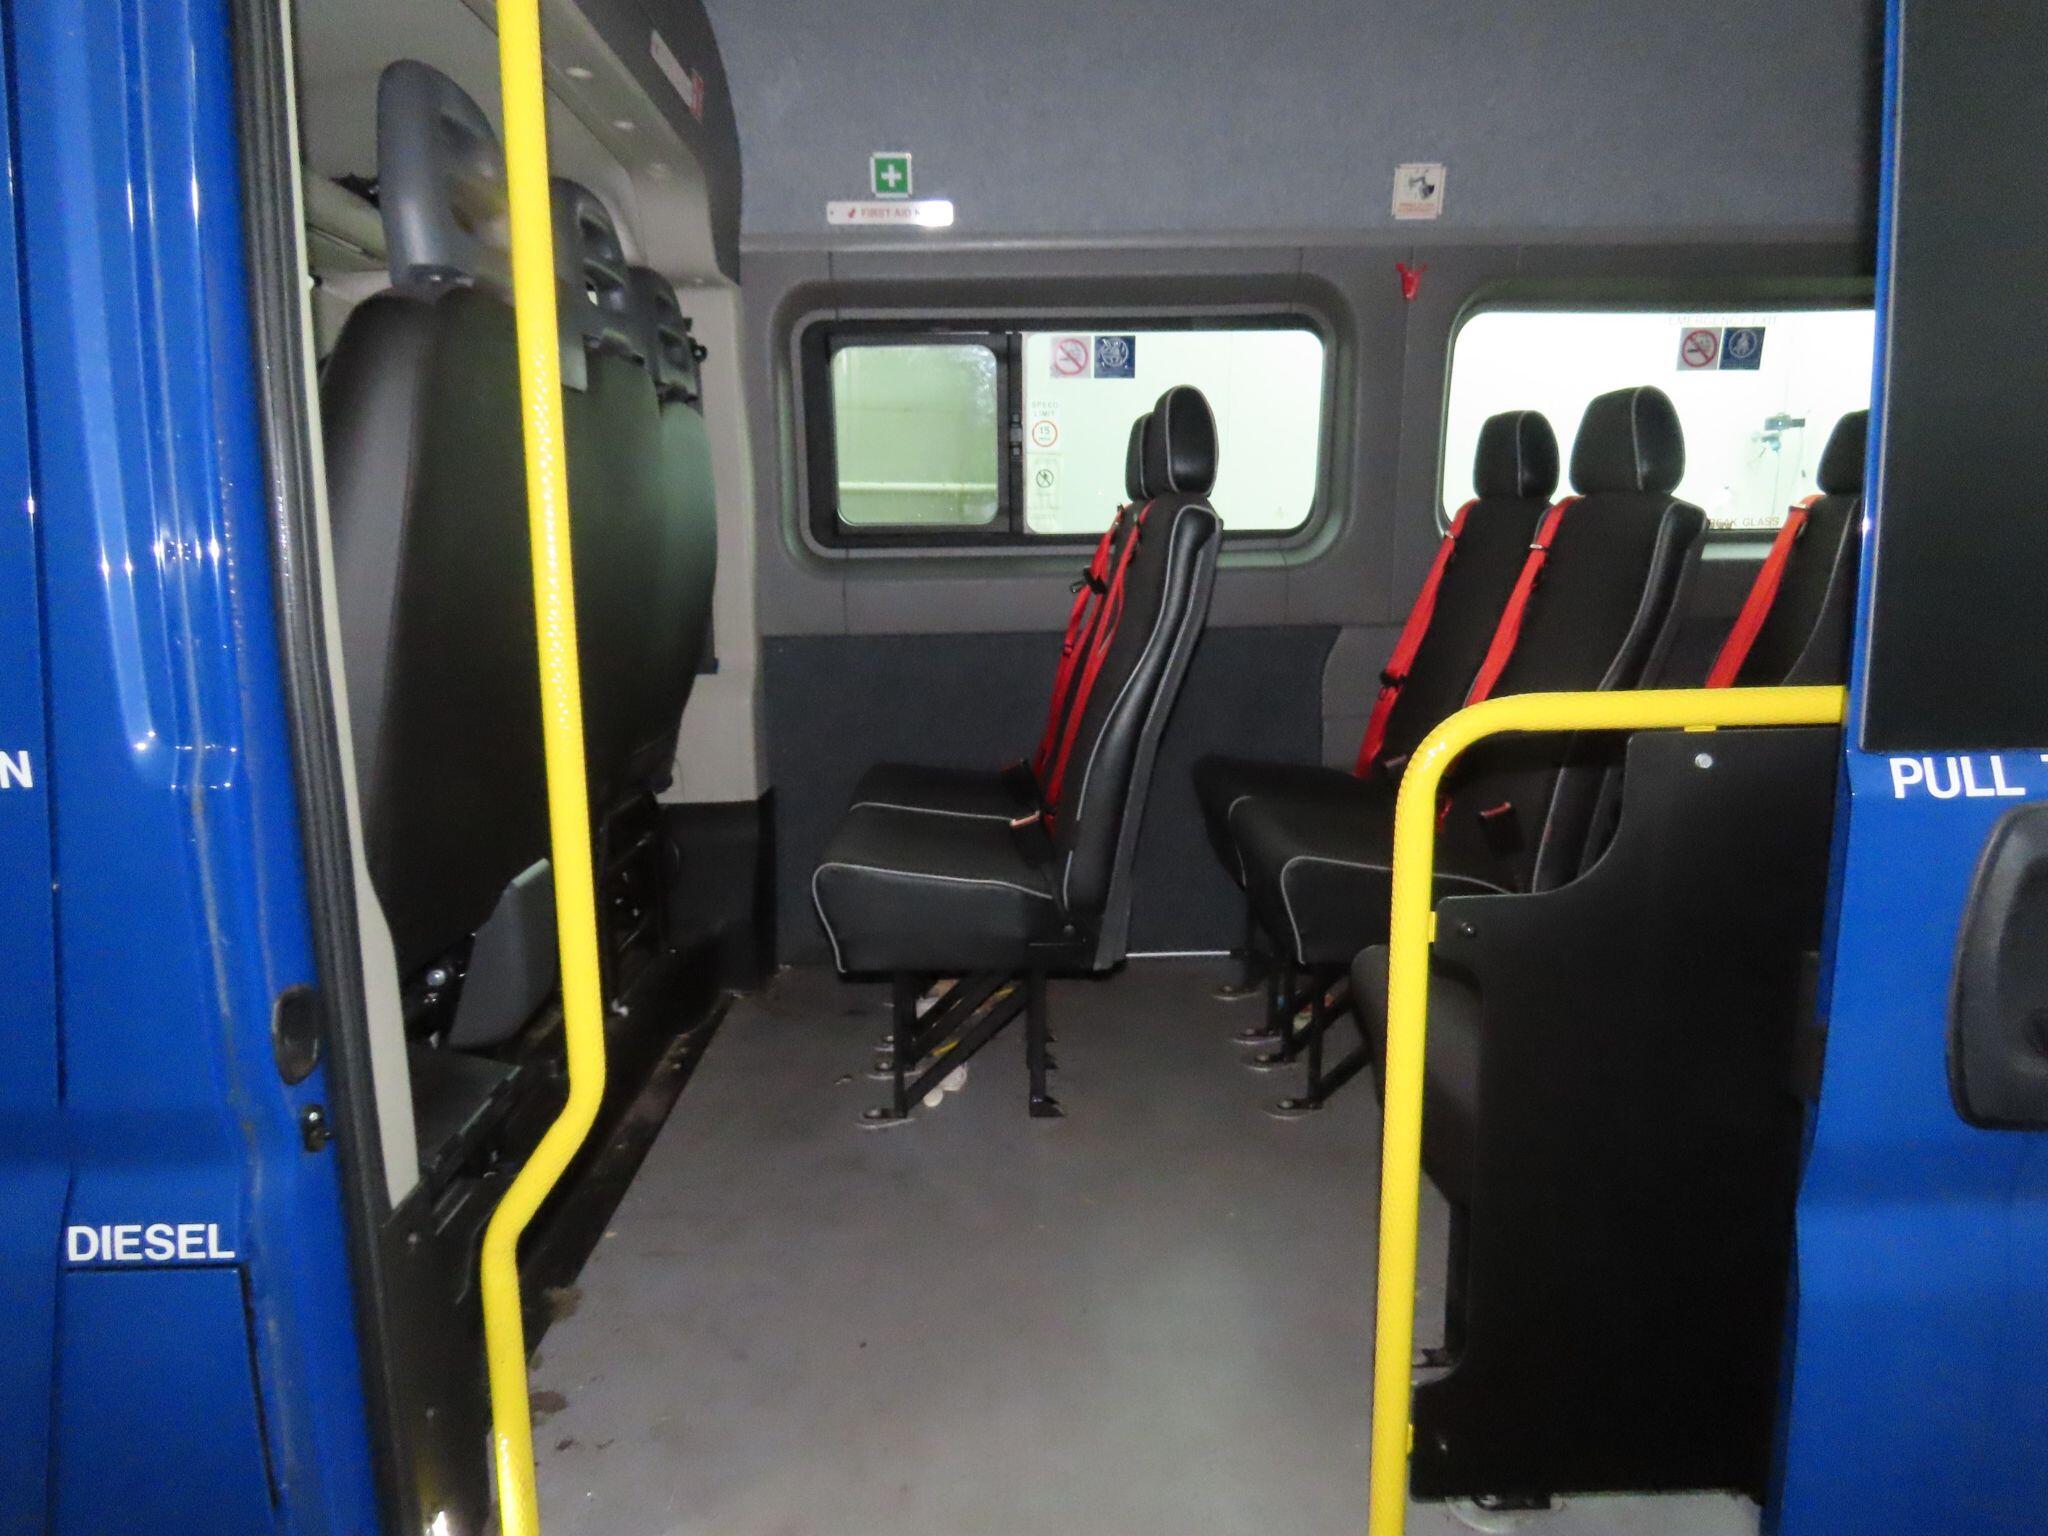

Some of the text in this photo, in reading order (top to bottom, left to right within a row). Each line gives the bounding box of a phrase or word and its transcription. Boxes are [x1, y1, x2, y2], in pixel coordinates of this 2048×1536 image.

[861, 207, 890, 218] FIRST
[894, 207, 912, 218] AID
[1031, 400, 1059, 409] SPEED
[1033, 409, 1055, 417] LIMIT
[1040, 425, 1051, 435] 15
[1742, 516, 1780, 527] GLASS
[1889, 755, 2026, 799] PULL
[67, 1223, 236, 1262] DIESEL
